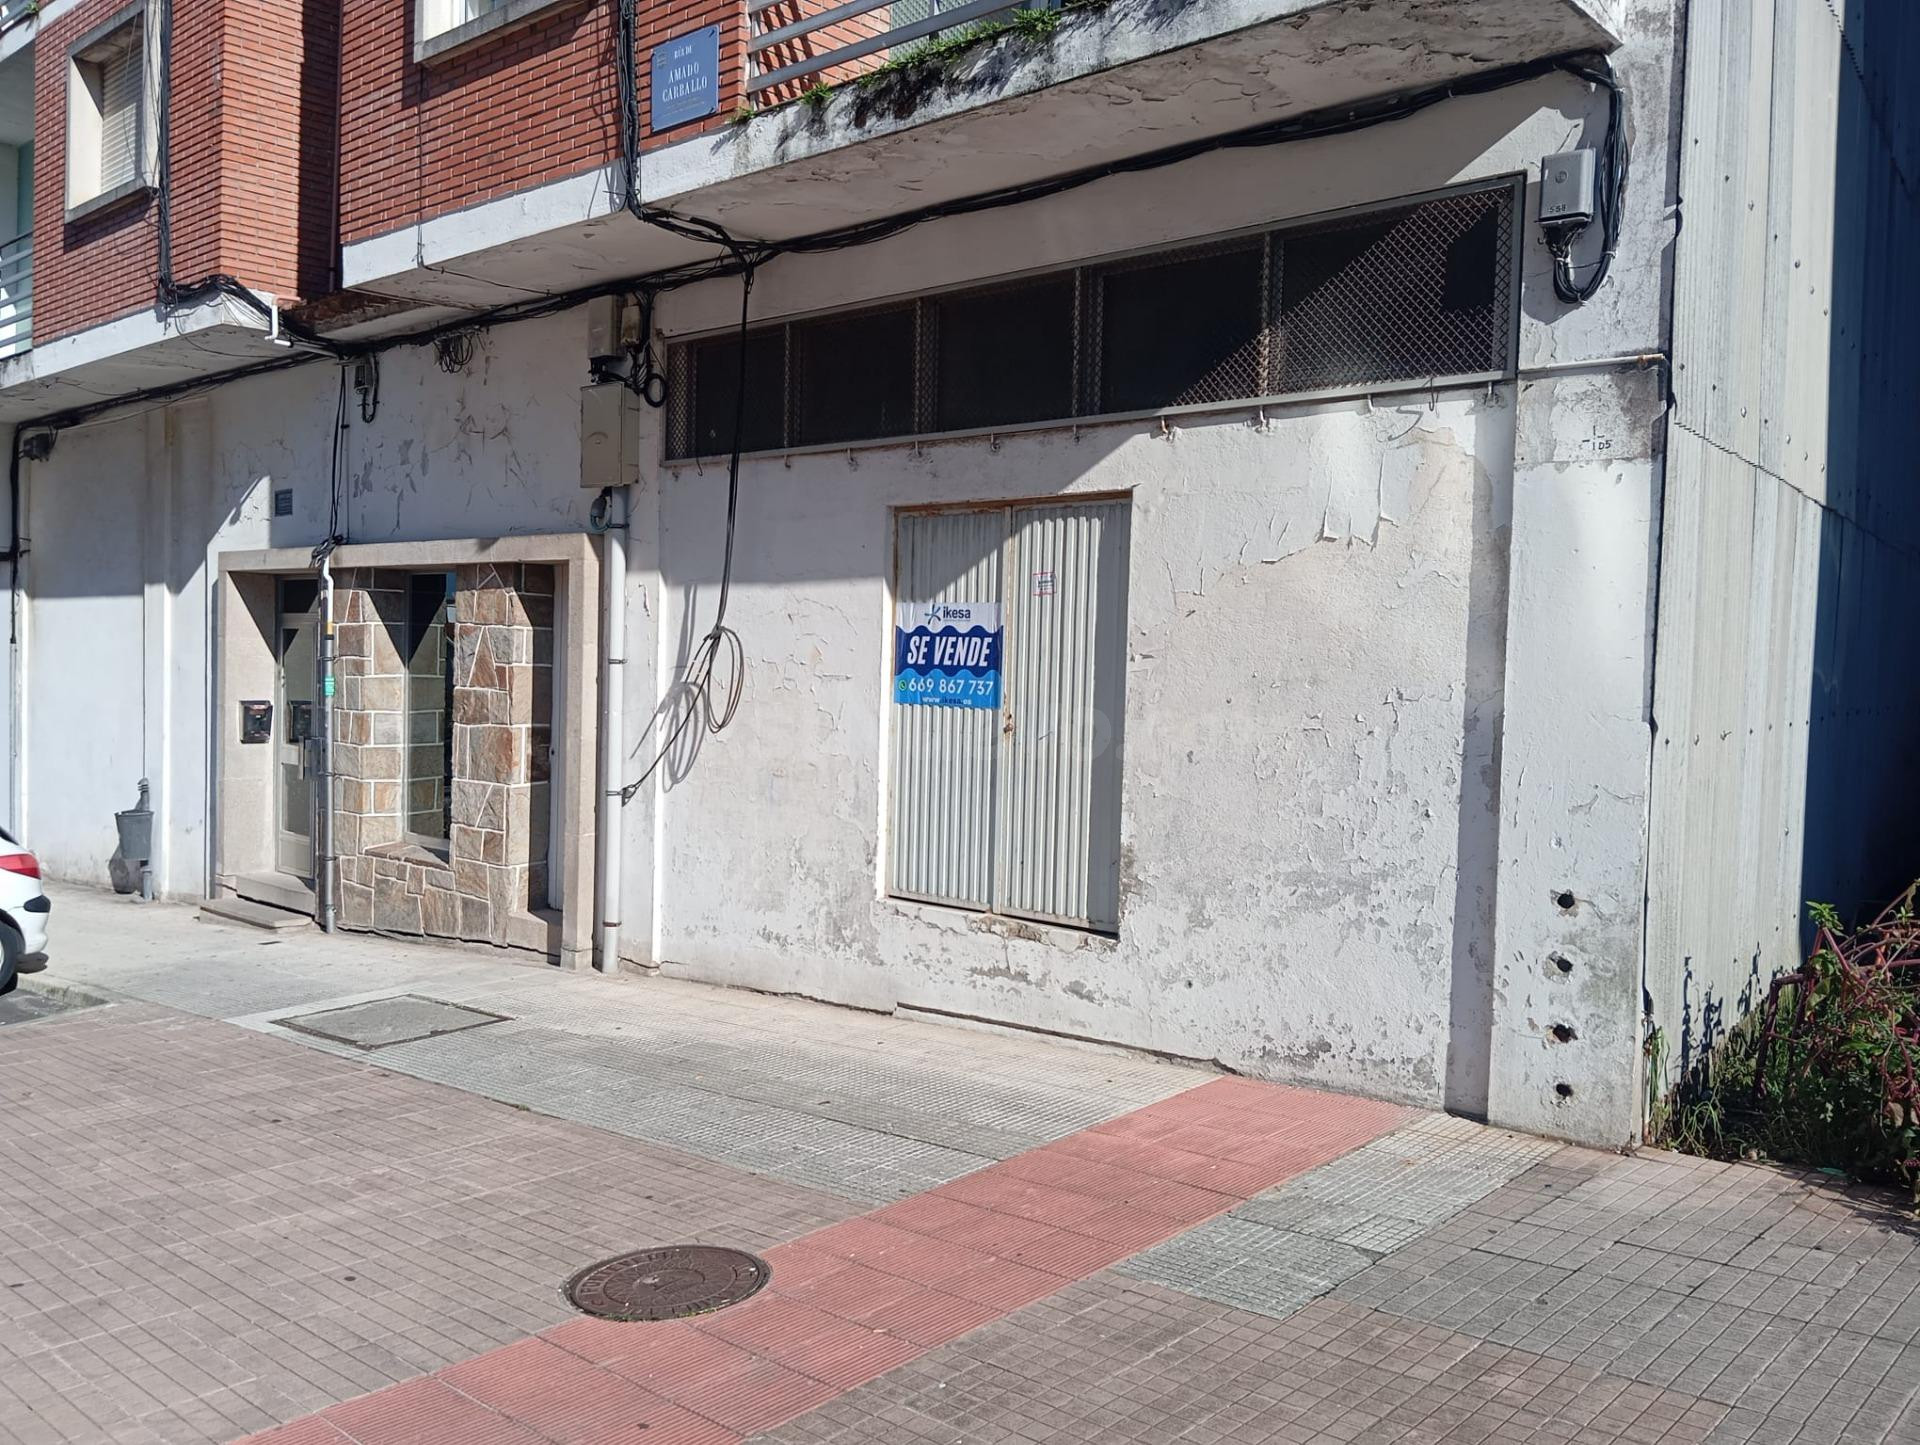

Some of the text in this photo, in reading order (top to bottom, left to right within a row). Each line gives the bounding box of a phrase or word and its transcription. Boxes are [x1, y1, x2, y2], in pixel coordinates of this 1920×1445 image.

[668, 62, 700, 84] AMADO
[662, 75, 708, 102] CARBALLO
[943, 605, 971, 619] ikesa
[907, 635, 993, 667] SE VENDE
[908, 678, 995, 696] 669 867 737
